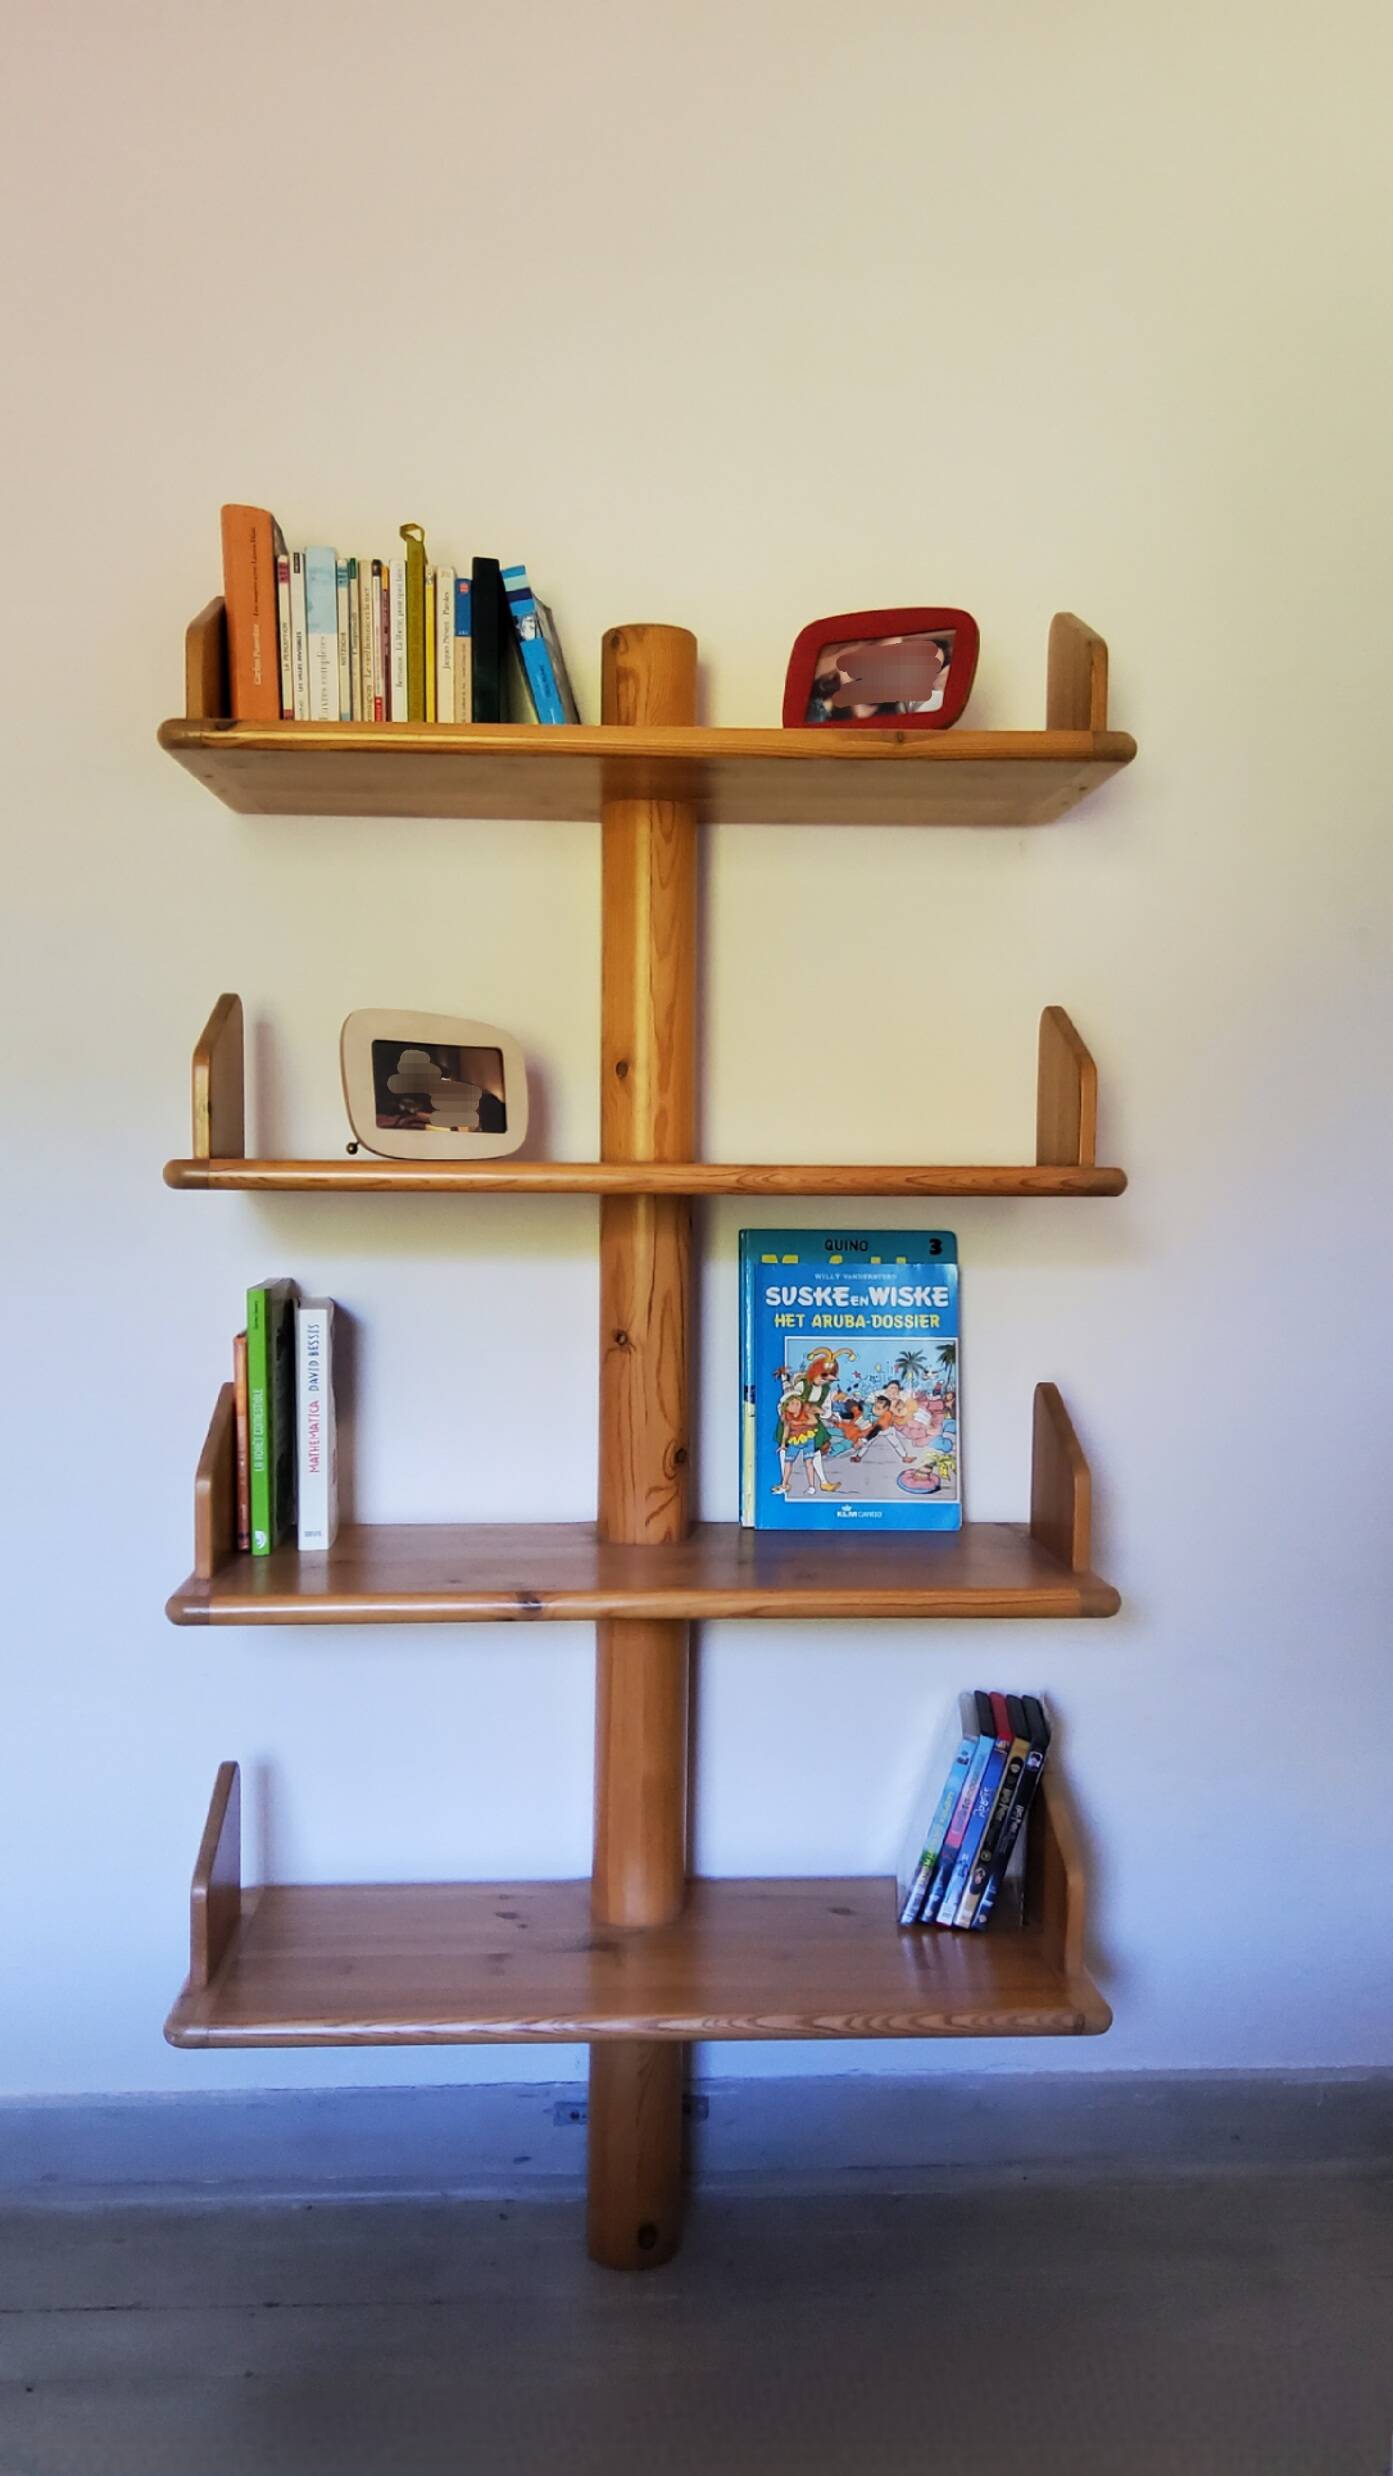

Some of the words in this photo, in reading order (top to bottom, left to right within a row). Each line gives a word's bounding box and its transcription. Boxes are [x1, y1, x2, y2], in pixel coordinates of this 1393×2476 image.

[825, 1239, 870, 1253] QUINO
[928, 1238, 943, 1257] 3
[814, 1272, 841, 1281] WILLY
[765, 1285, 849, 1308] SUSKE
[869, 1285, 950, 1308] WISKE
[773, 1313, 806, 1329] HET
[811, 1313, 941, 1330] ARUBA-DOSSIER
[305, 1323, 320, 1357] BESSIS
[306, 1359, 321, 1392] DAVID
[307, 1400, 322, 1473] MATHEMATICA
